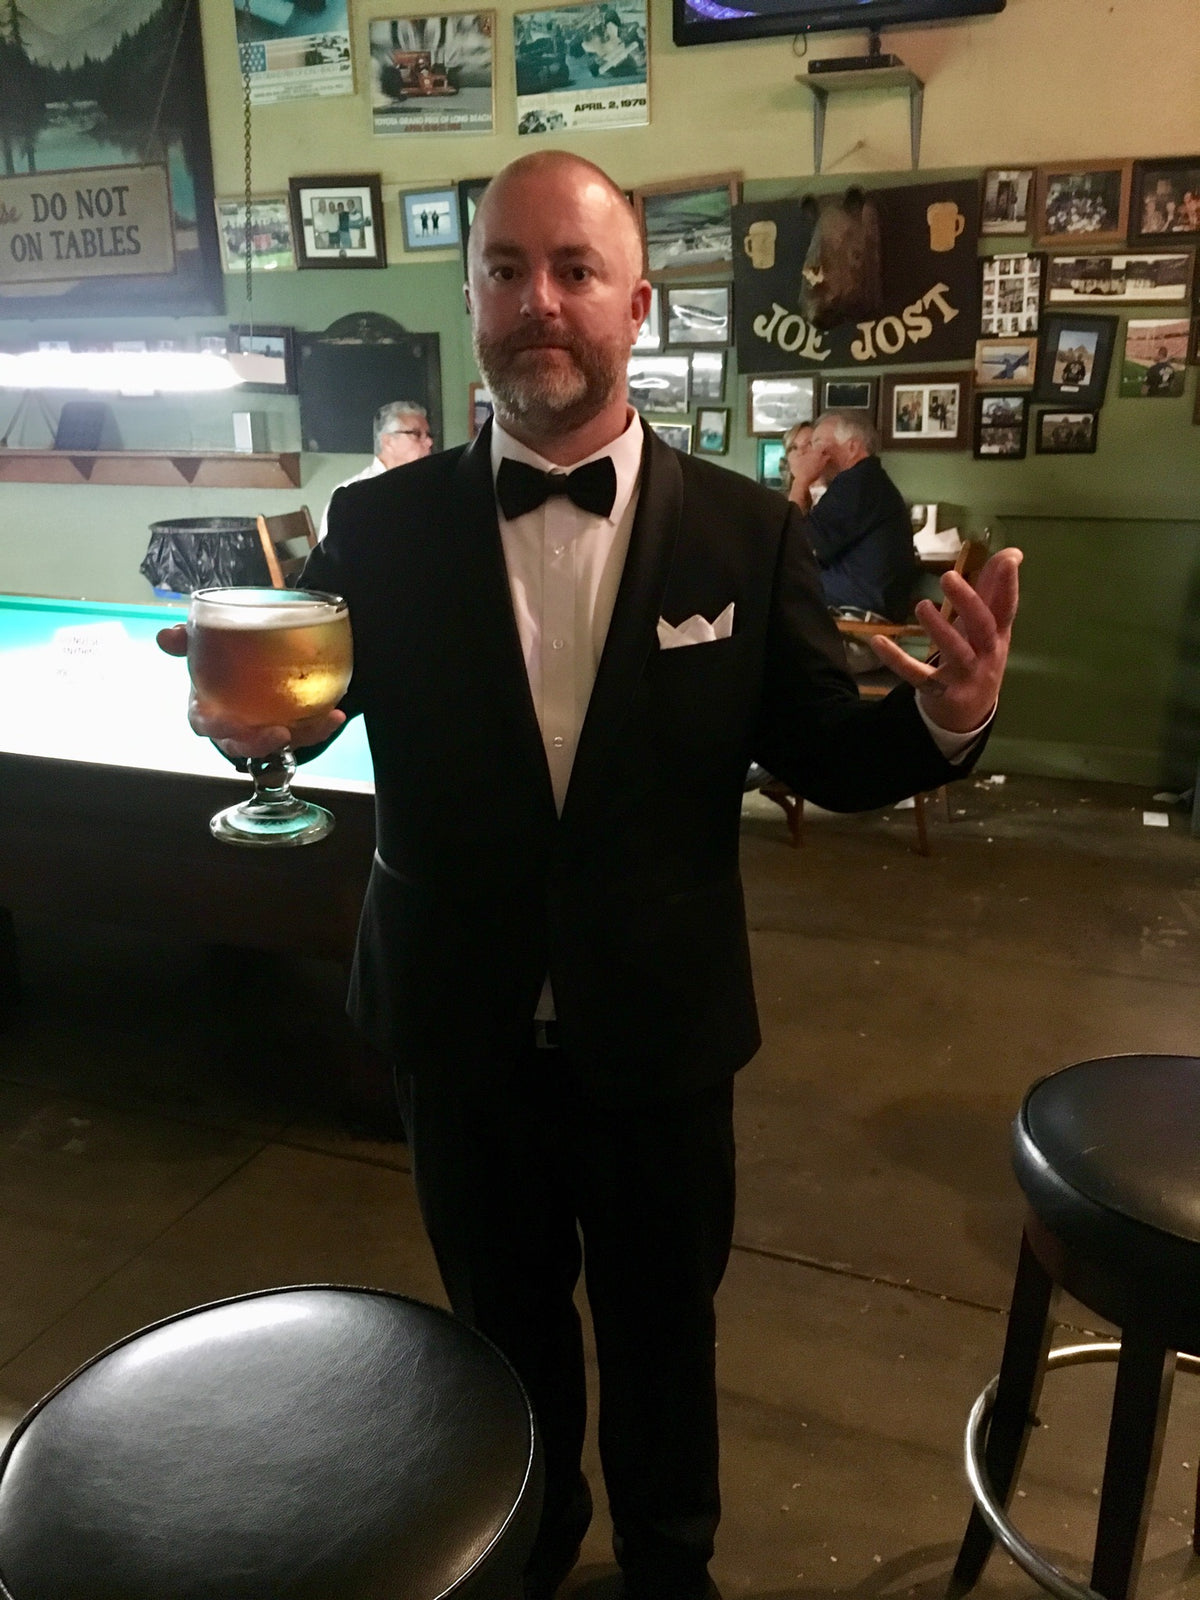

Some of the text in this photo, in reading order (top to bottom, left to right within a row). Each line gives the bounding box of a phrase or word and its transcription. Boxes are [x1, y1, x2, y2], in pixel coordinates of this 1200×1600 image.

[574, 101, 606, 113] APRIL
[30, 192, 67, 223] DO
[75, 185, 129, 220] NOT
[10, 225, 141, 262] ON TABLES
[753, 282, 959, 361] JOE JOST
